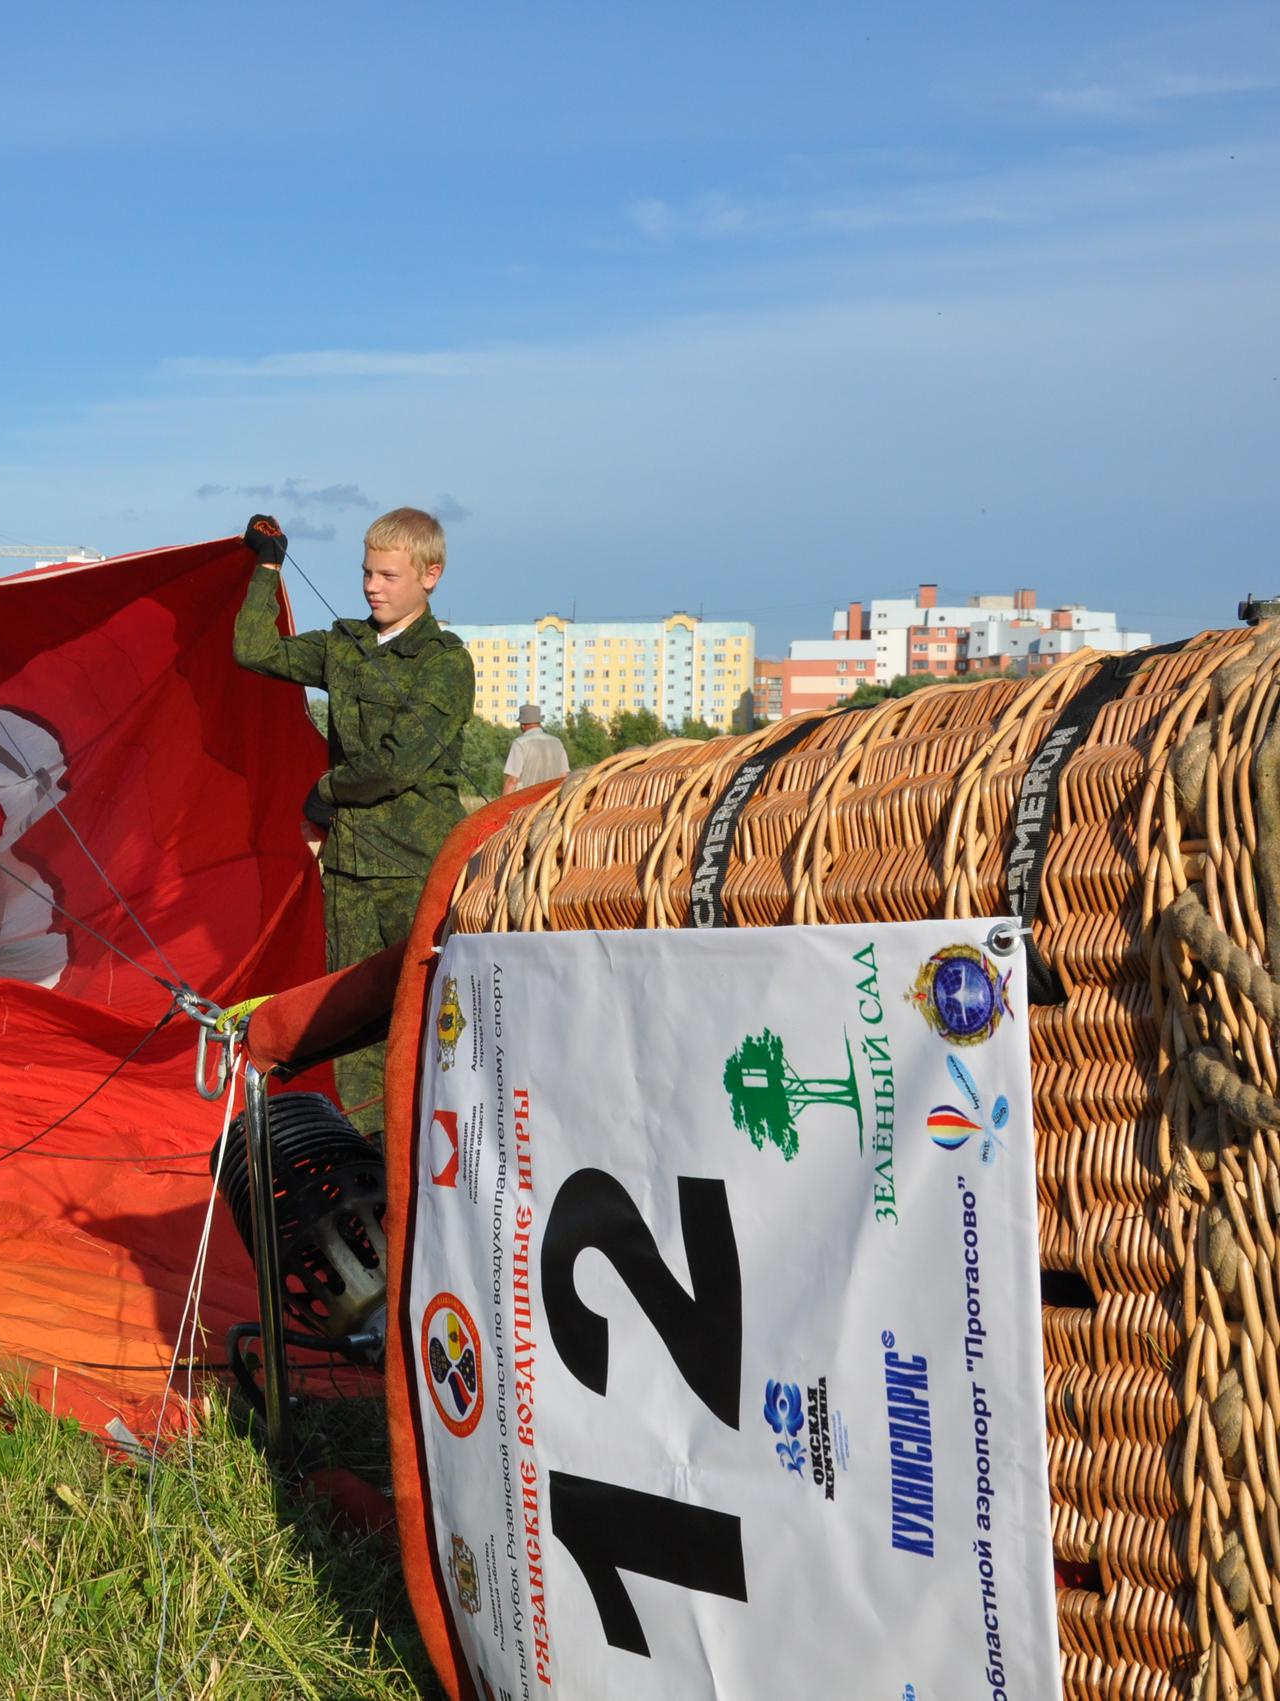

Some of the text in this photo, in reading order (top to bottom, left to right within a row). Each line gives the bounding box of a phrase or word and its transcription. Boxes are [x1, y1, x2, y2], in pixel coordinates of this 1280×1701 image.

[691, 764, 765, 929] CAMERON
[1008, 725, 1078, 917] CAMERON
[492, 962, 504, 1039] спорту
[851, 942, 898, 1227] ЗЕЛЁНЫЙ САД
[491, 1044, 507, 1305] воздухоплавательному
[494, 1312, 502, 1339] по
[512, 1087, 551, 1689] РЯЗАНСКИЕ ВОЗДУШНЫЕ ИГРЫ
[494, 1345, 507, 1437] области
[540, 1167, 749, 1659] 12
[807, 1384, 824, 1486] ОКСКАЯ
[818, 1376, 835, 1502] ЖЕМЧУЖИНА
[499, 1444, 516, 1560] Рязанской
[884, 1351, 934, 1558] КУХНИСПАРКС
[971, 1381, 997, 1532] аэропорт
[484, 1541, 499, 1638] Правительство
[489, 1534, 505, 1652] Рязанской области
[511, 1567, 524, 1632] Кубок
